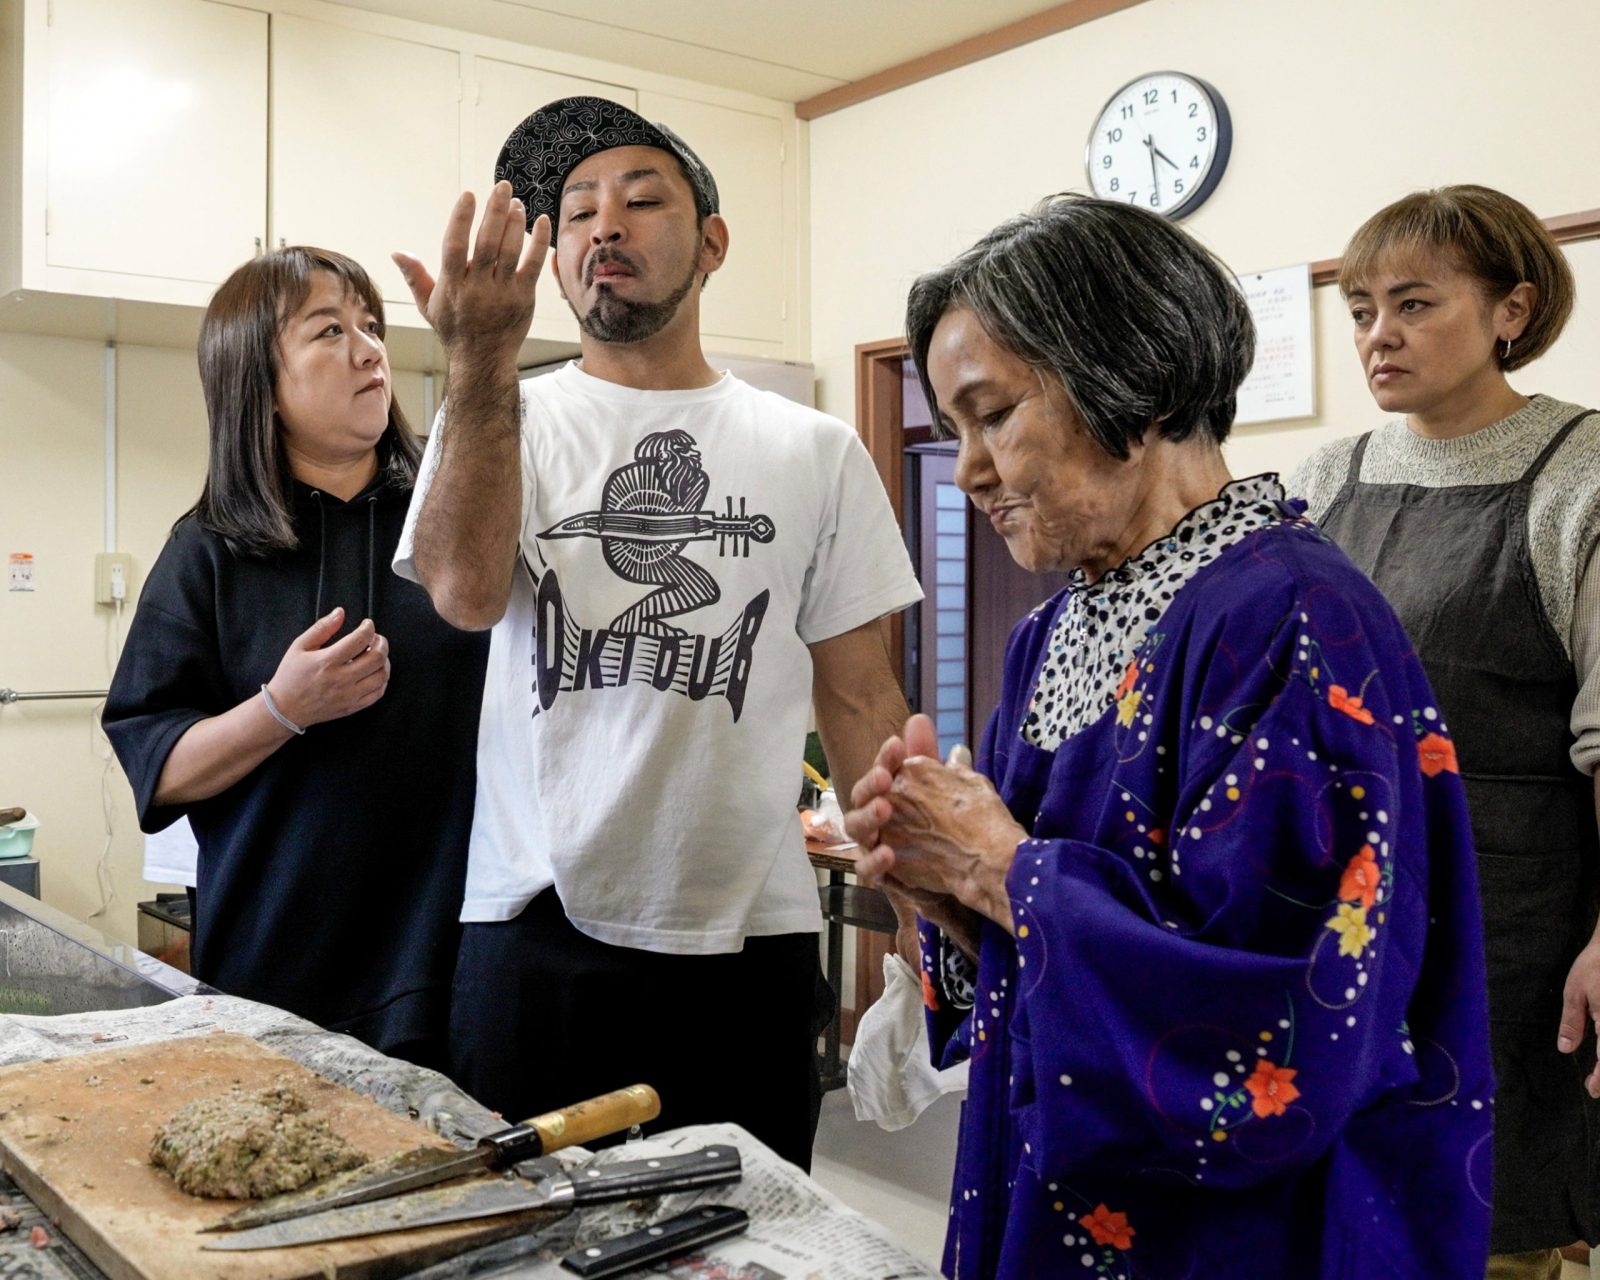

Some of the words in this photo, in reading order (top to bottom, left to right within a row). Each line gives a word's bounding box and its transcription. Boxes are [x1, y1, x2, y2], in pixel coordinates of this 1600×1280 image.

[1143, 89, 1159, 105] 12
[1171, 89, 1177, 104] 1
[1121, 104, 1134, 120] 11
[1188, 103, 1198, 118] 2
[1107, 128, 1122, 144] 10
[1196, 127, 1207, 142] 3
[1103, 155, 1112, 169] 9
[1189, 155, 1199, 169] 4
[1110, 177, 1120, 192] 8
[1174, 179, 1184, 194] 5
[1128, 192, 1137, 206] 7
[1150, 193, 1160, 207] 6
